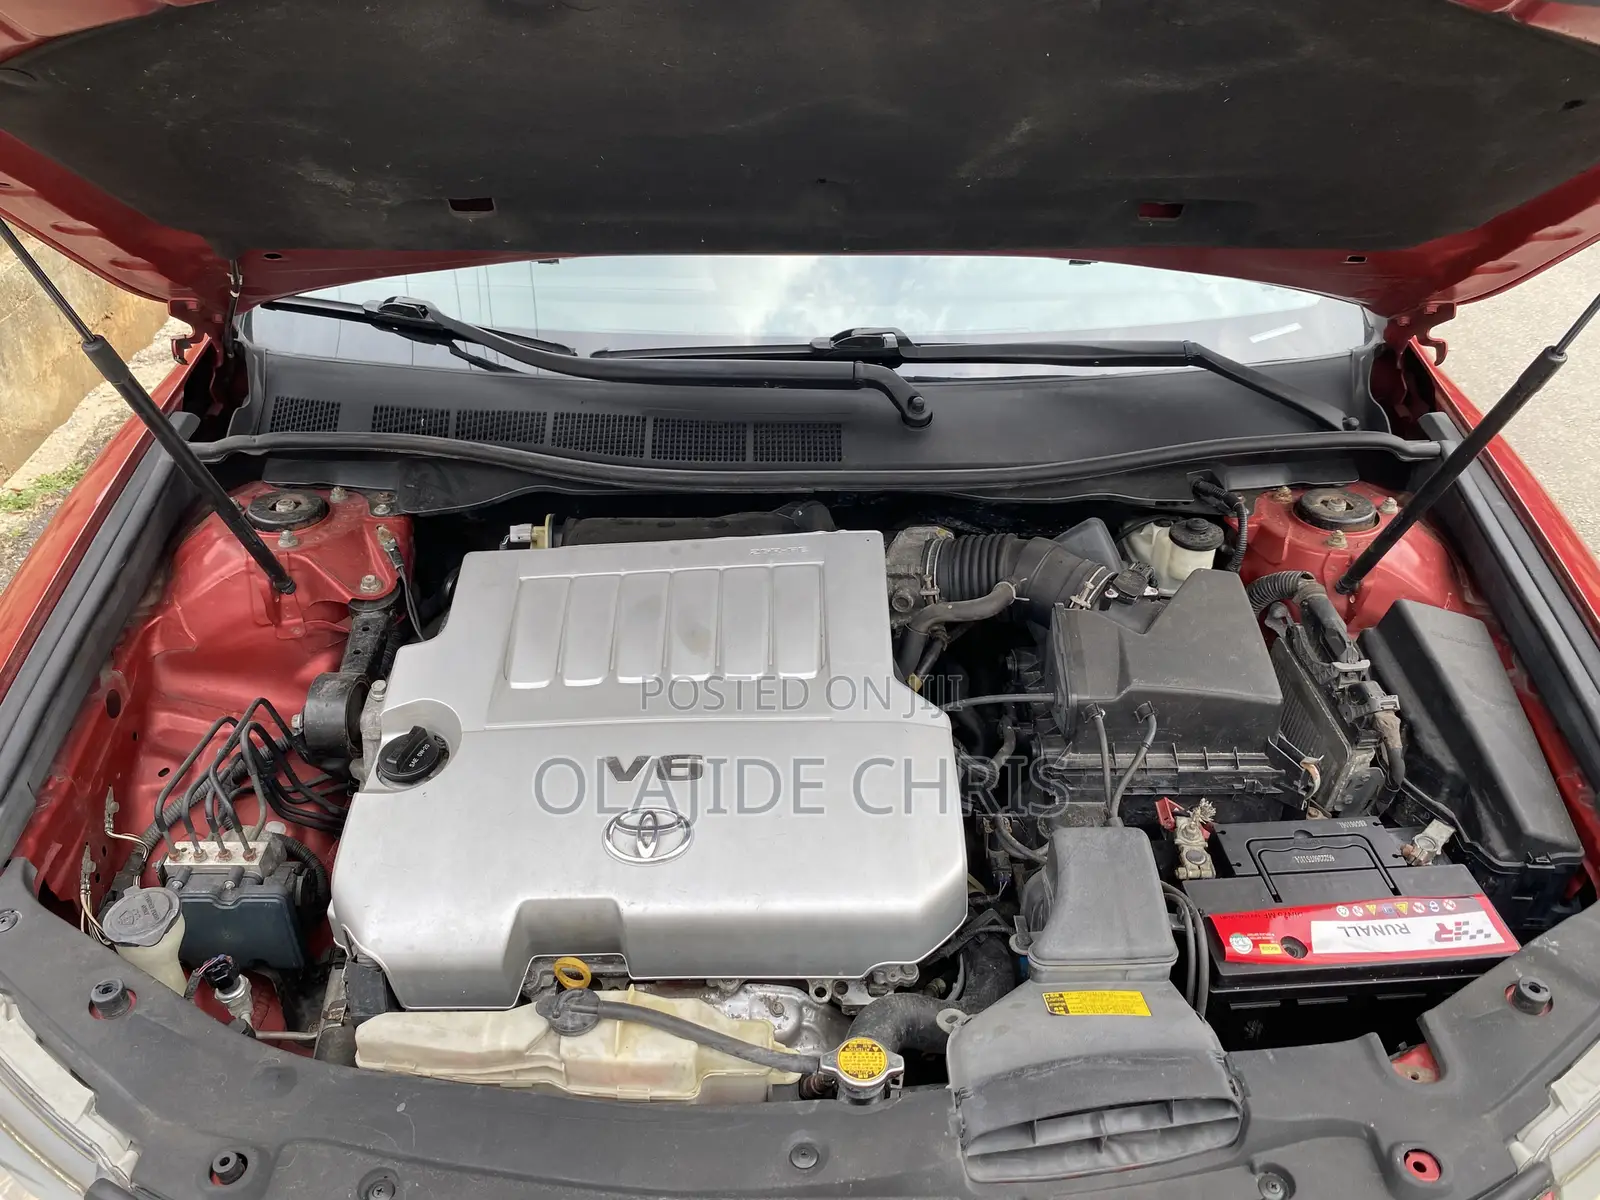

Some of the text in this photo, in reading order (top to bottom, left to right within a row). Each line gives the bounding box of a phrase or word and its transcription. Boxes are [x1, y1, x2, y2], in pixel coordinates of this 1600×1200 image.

[409, 744, 430, 767] SAE 0W-20
[604, 754, 704, 782] V6
[1336, 922, 1412, 938] RUNALL
